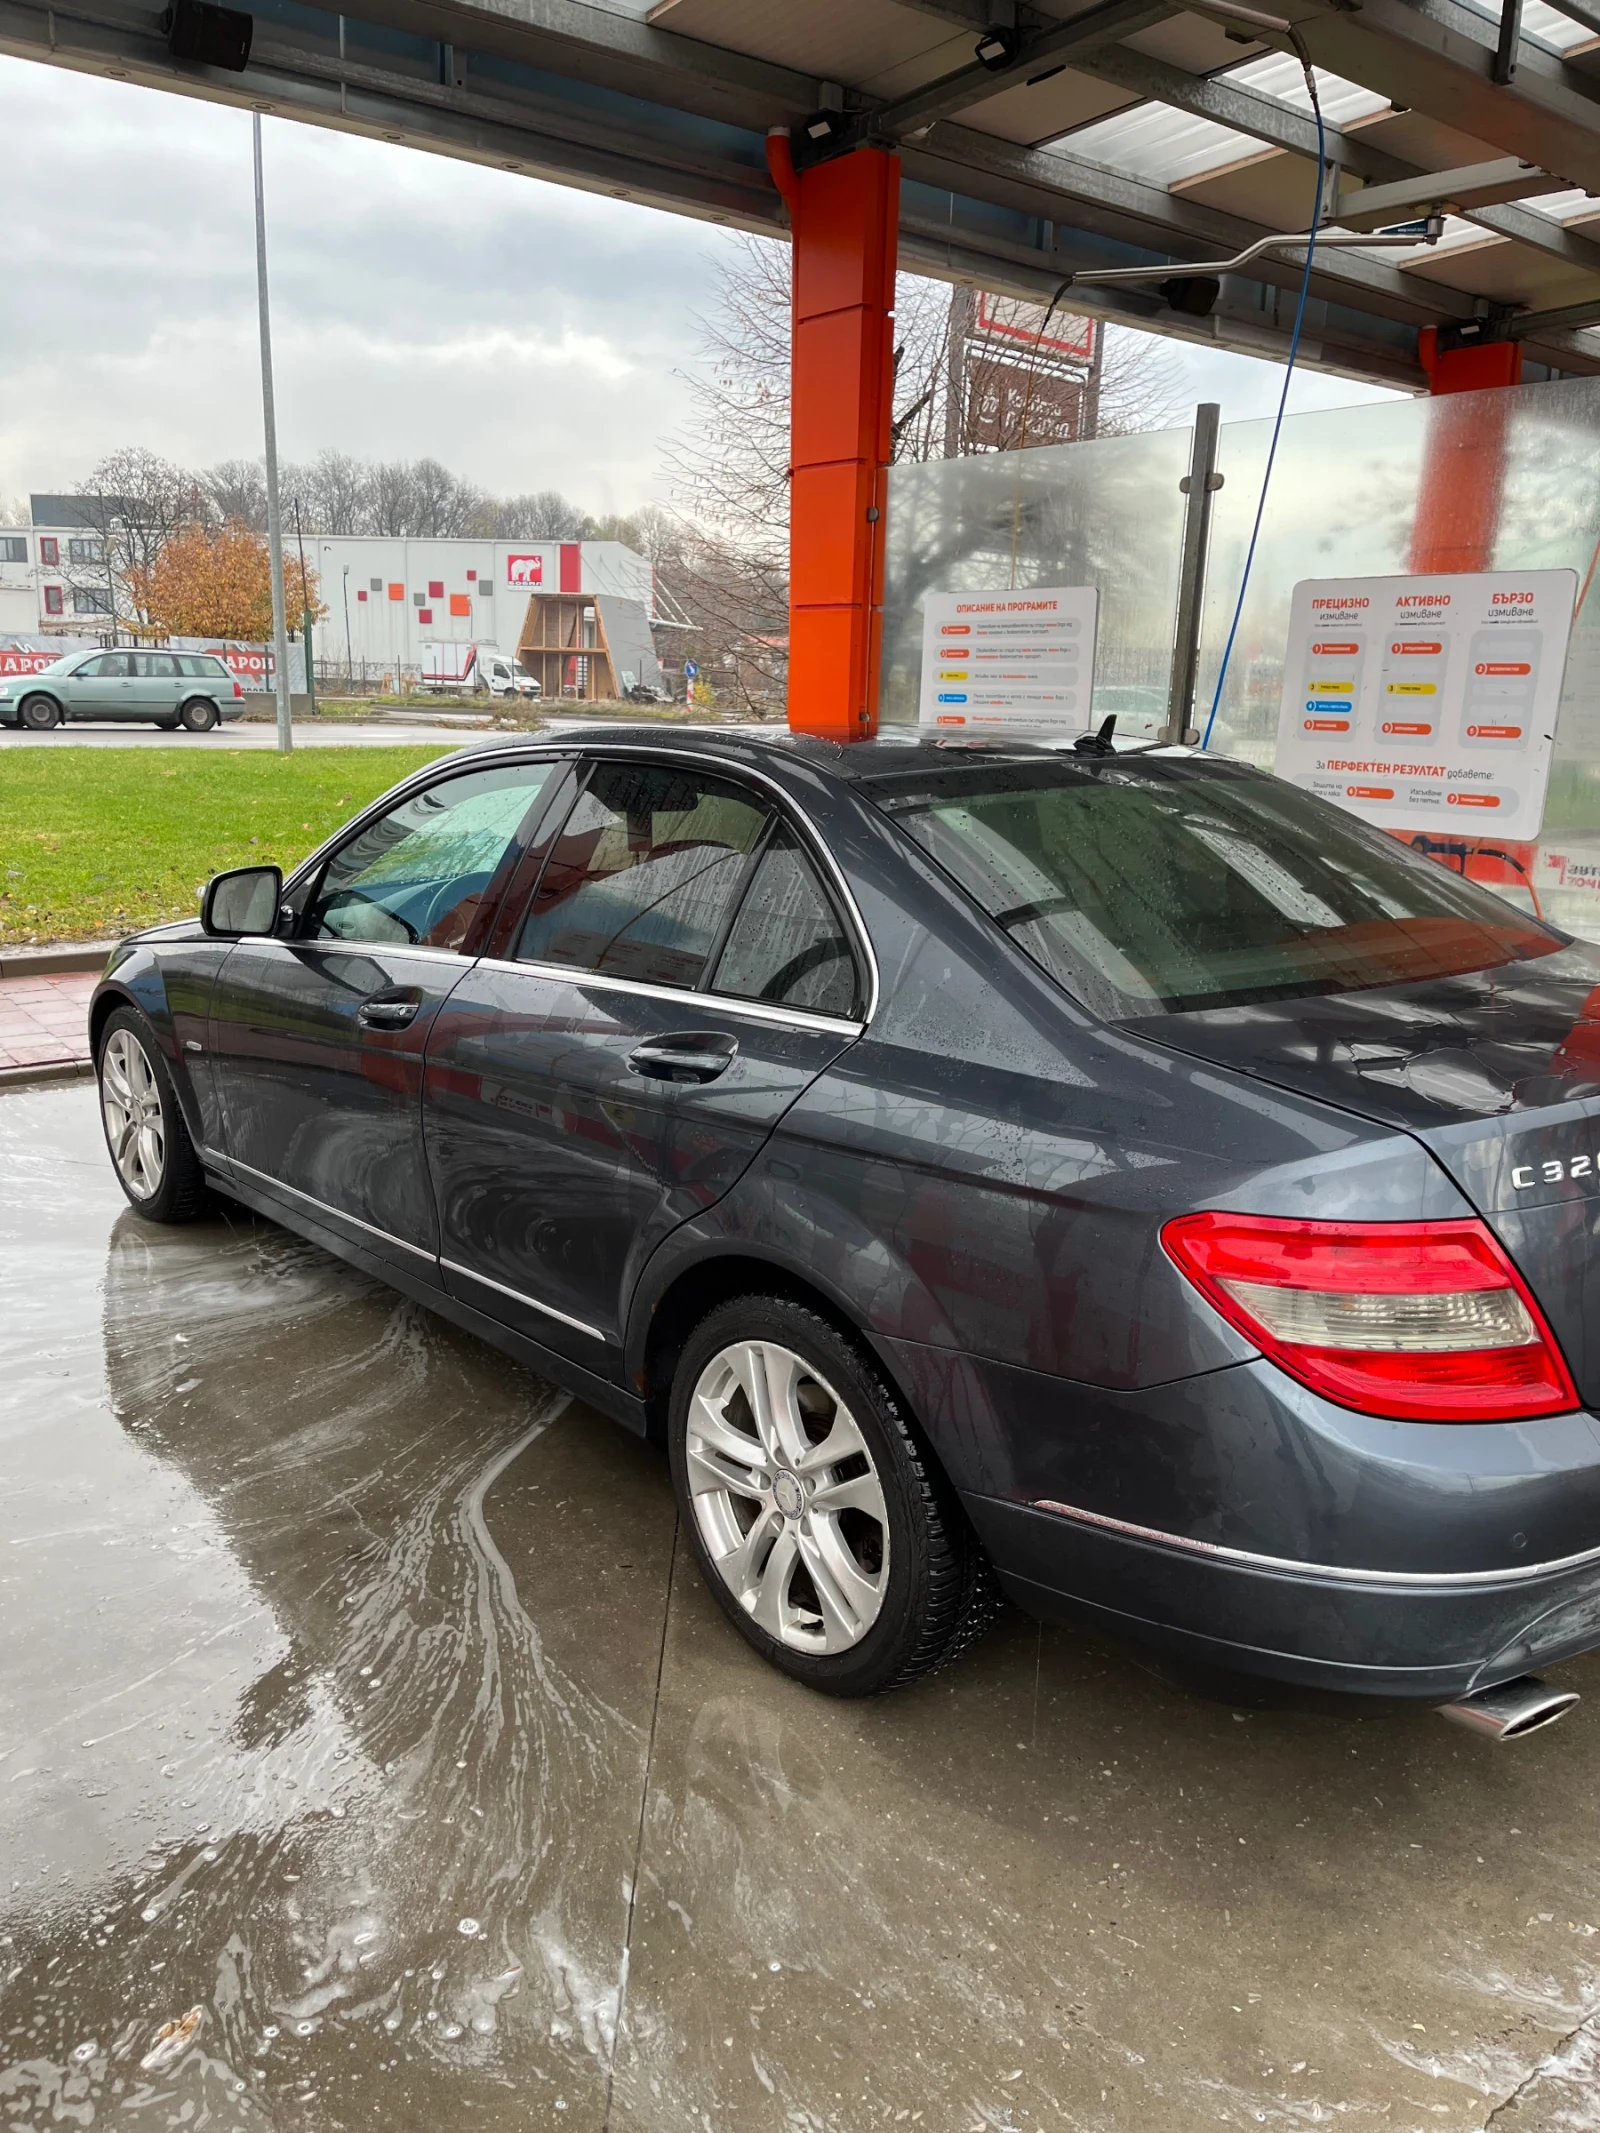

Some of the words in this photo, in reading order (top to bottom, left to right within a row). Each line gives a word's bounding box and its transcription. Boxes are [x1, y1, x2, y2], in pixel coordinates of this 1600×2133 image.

[1312, 597, 1370, 610] ПРЕЦИЗНО
[1395, 595, 1451, 607] АКТИВНО
[1492, 592, 1534, 604] БЪРЗО
[956, 603, 995, 613] ОПИСАНИЕ
[996, 602, 1006, 612] НА
[1008, 600, 1058, 611] ПРОГРАМИТЕ
[1488, 606, 1534, 617] измиване
[1320, 611, 1359, 620] измиване
[1400, 609, 1442, 619] измиване
[1315, 760, 1325, 770] За
[1327, 760, 1391, 774] ПЕРФЕКТЕН
[1392, 764, 1446, 777] РЕЗУЛТАТ
[1447, 769, 1495, 780] добавете:
[1511, 1151, 1600, 1190] C32
